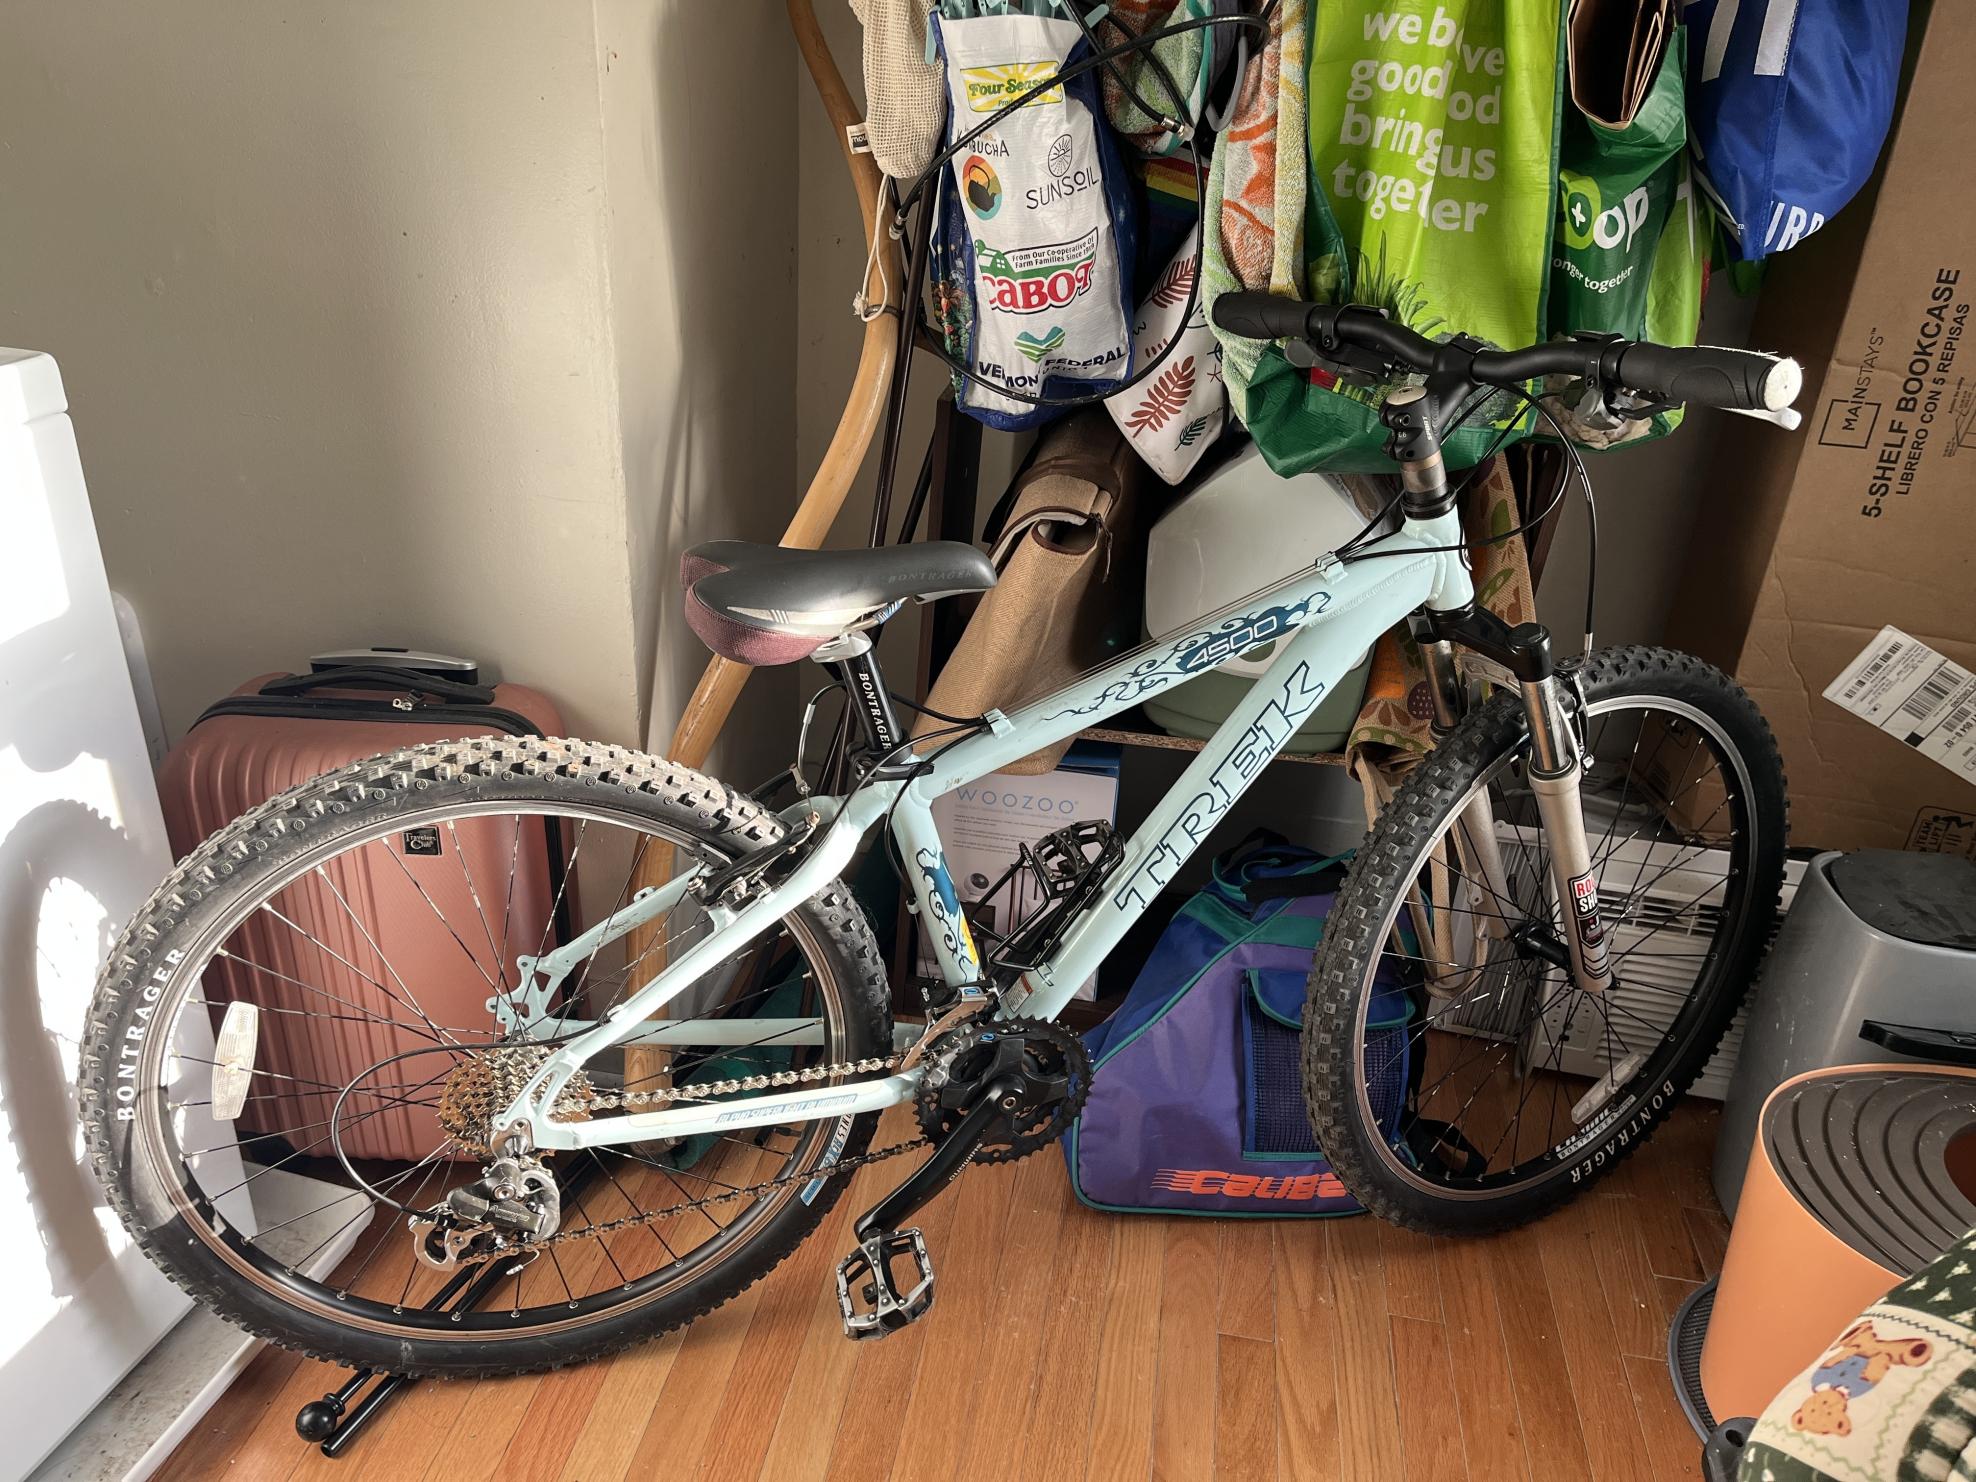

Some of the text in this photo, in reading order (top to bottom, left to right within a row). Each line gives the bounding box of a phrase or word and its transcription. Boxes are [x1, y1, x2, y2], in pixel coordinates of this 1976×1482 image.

[1363, 11, 1421, 44] we
[968, 83, 1005, 96] Four
[1346, 59, 1452, 101] good
[1339, 103, 1496, 181] bring us
[1026, 166, 1099, 209] SUNSOIL
[1331, 158, 1488, 232] togeter
[1012, 253, 1031, 262] From
[1032, 250, 1045, 259] Our
[1015, 260, 1034, 269] Farm
[1035, 256, 1065, 266] Families
[1066, 251, 1083, 261] Since
[1937, 303, 1970, 373] REPISAS
[1861, 268, 1961, 518] 5-SHELF BOOKCASE
[1933, 377, 1946, 386] 5
[1920, 390, 1942, 424] CON
[1896, 428, 1929, 495] LIBRERO
[887, 569, 976, 584] BONTRAGER
[1188, 615, 1278, 669] 4500
[858, 672, 892, 751] BONTRAGER
[957, 787, 1074, 814] WOOZOO
[1113, 660, 1326, 911] TREK
[1576, 876, 1596, 897] RO
[1579, 888, 1598, 913] SH
[117, 949, 185, 1121] BONTRAGER
[1571, 1079, 1674, 1185] BONTRAGER
